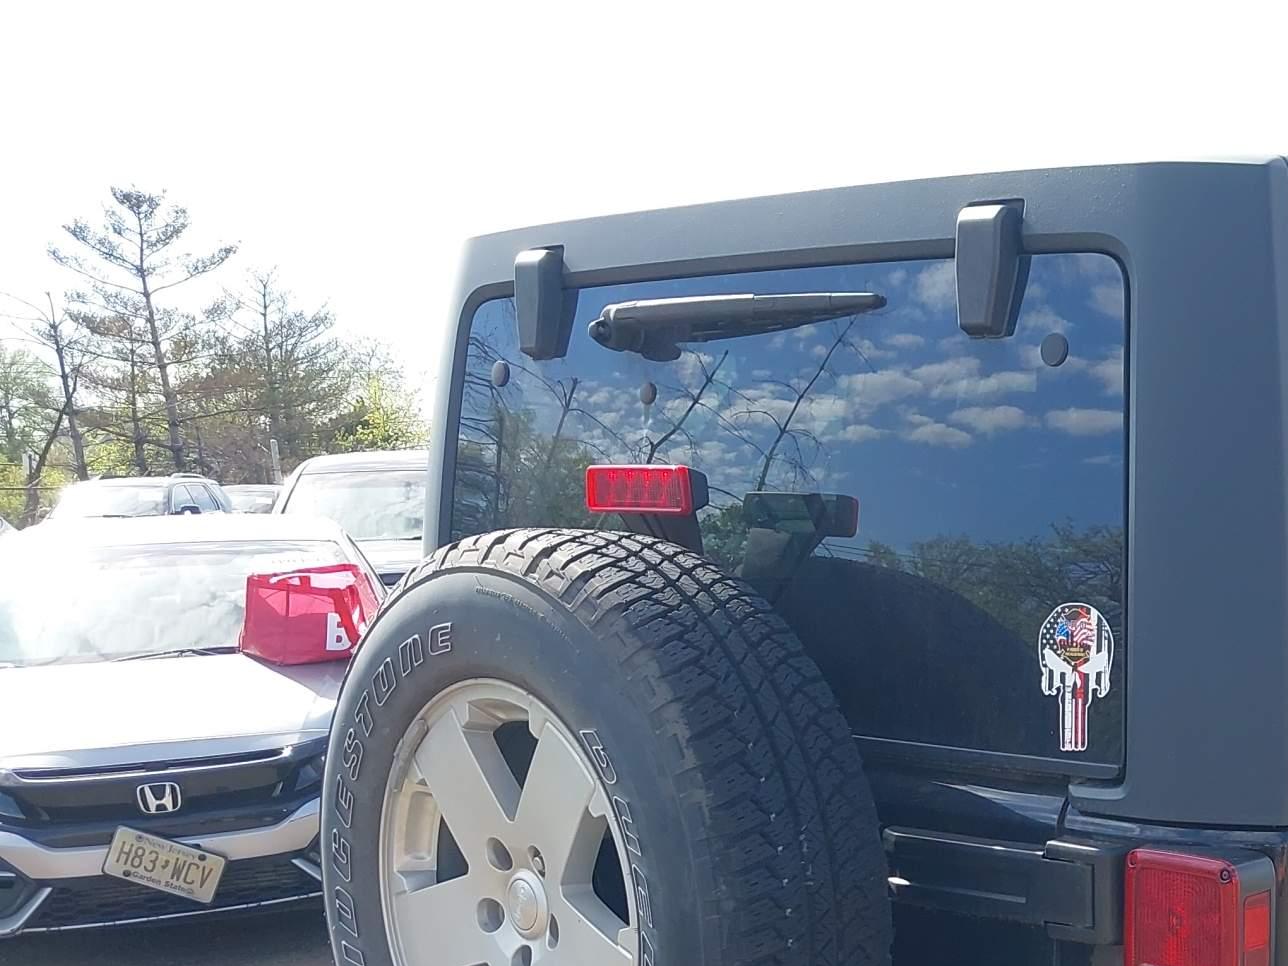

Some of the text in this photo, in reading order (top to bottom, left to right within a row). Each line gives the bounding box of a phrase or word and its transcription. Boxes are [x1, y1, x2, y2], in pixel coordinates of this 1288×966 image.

[116, 841, 214, 889] H83 WCV
[132, 871, 162, 886] Garden
